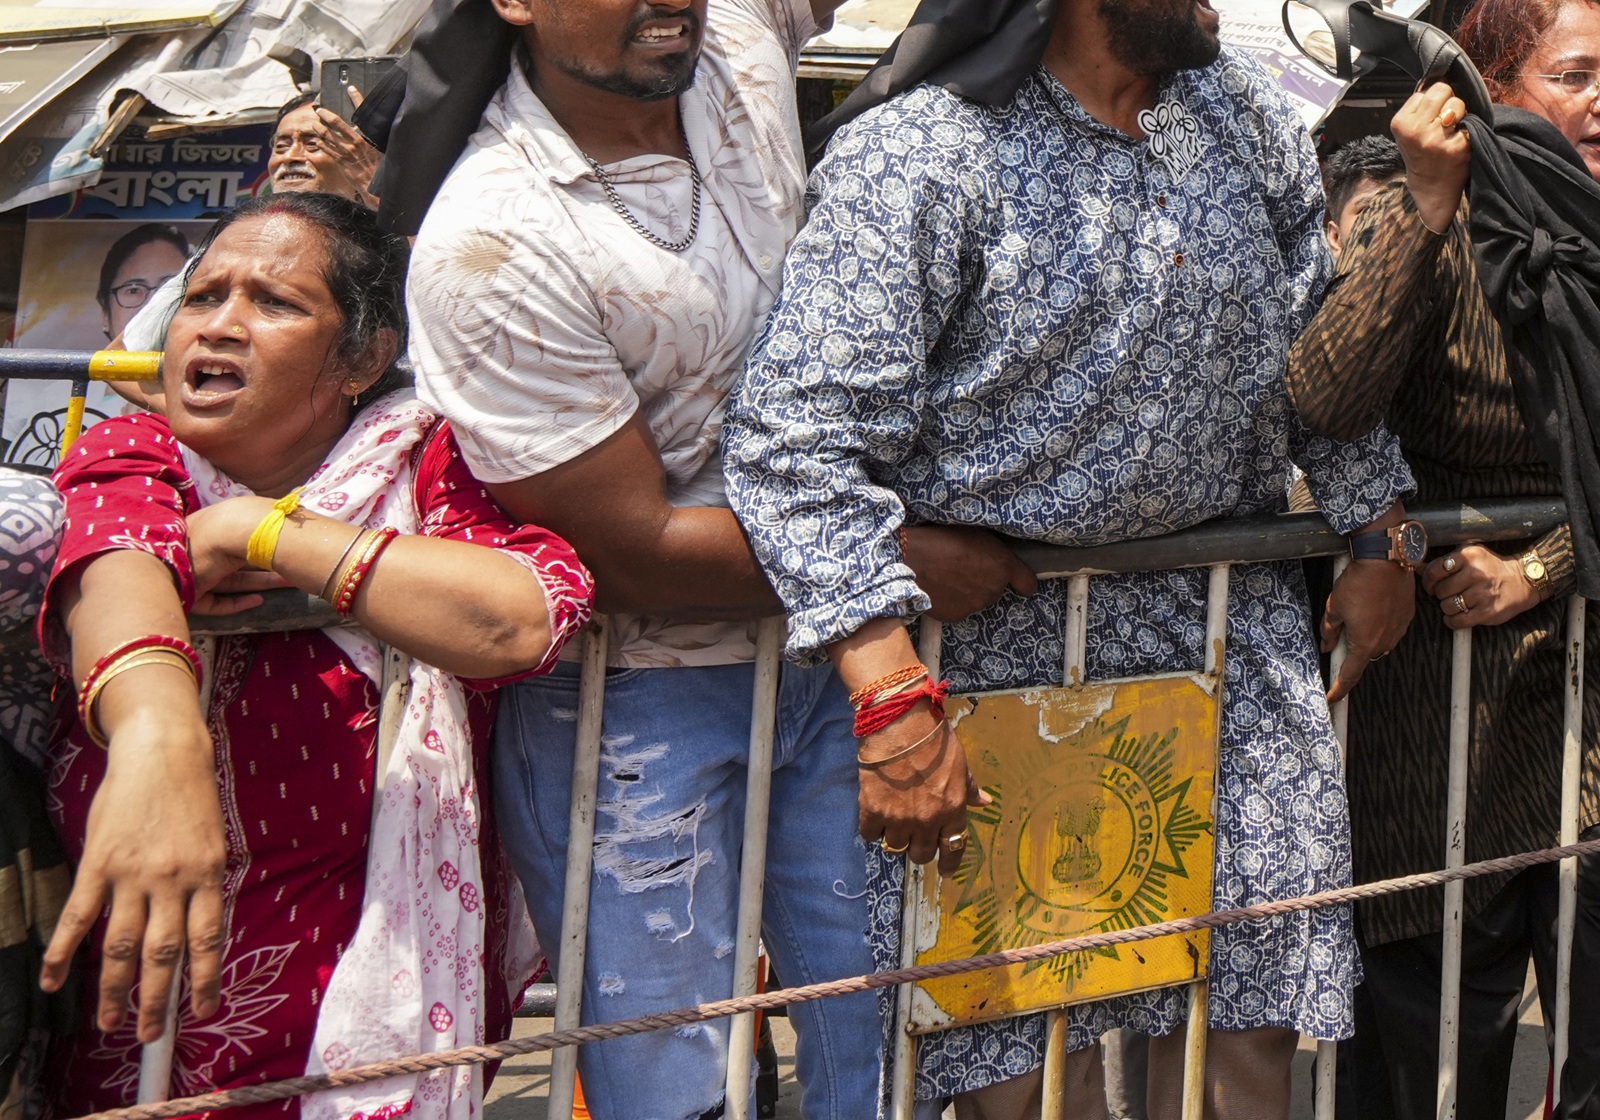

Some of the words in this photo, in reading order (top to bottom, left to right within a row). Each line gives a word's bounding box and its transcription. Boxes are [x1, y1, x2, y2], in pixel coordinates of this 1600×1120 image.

[172, 137, 263, 164] জিতবে
[92, 170, 244, 208] বাংলা
[1127, 799, 1154, 879] FORCE
